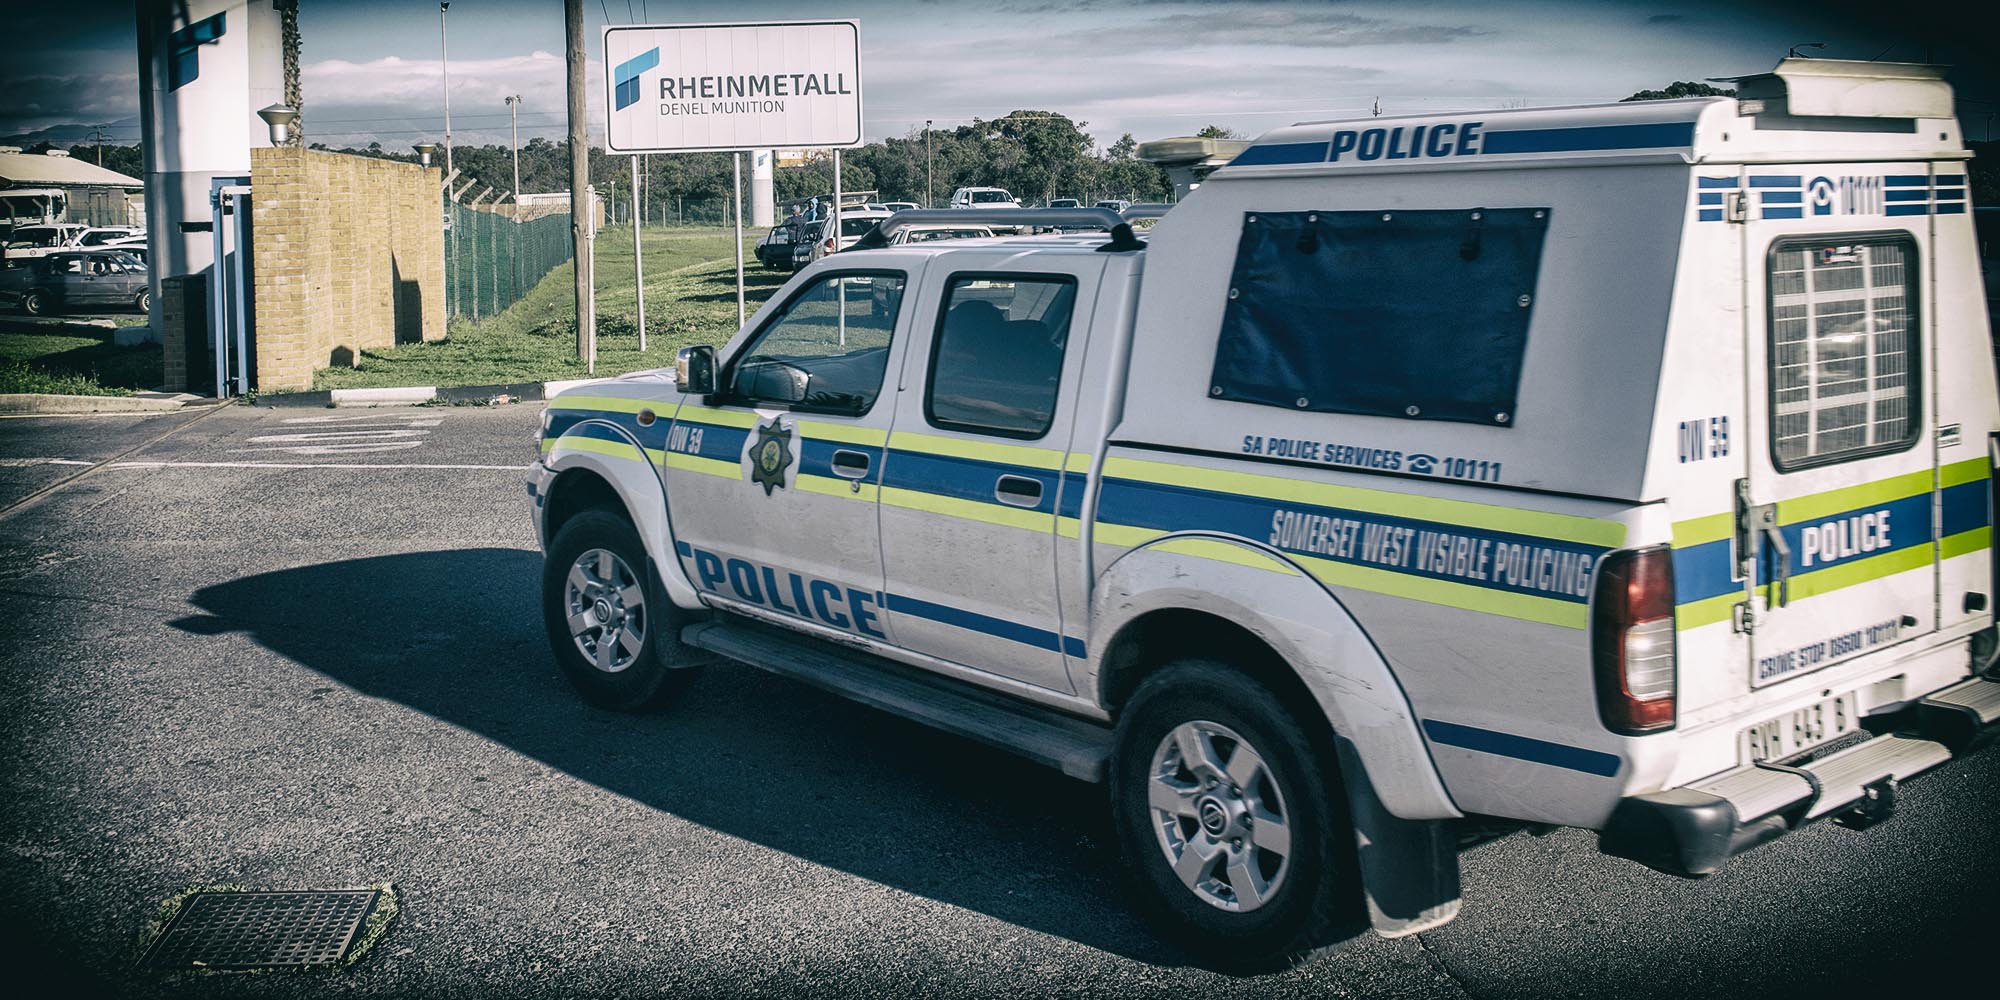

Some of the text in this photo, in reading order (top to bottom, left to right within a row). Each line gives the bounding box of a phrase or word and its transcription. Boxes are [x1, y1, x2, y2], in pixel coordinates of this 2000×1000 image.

[659, 73, 851, 100] RHEINMETALL
[660, 100, 785, 116] DENEL MUNITION
[1328, 121, 1484, 163] POLICE
[1840, 175, 1883, 215] 10111
[687, 427, 704, 454] 59
[1708, 415, 1729, 459] 59
[1241, 435, 1502, 482] SA POLICE SERVICES 10111
[1269, 509, 1593, 597] SOMERSET WEST VISIBLE POLICING
[1801, 510, 1892, 567] POLICE
[693, 547, 888, 640] POLICE
[1760, 651, 1795, 680] CRIME
[1798, 641, 1825, 668] STOP
